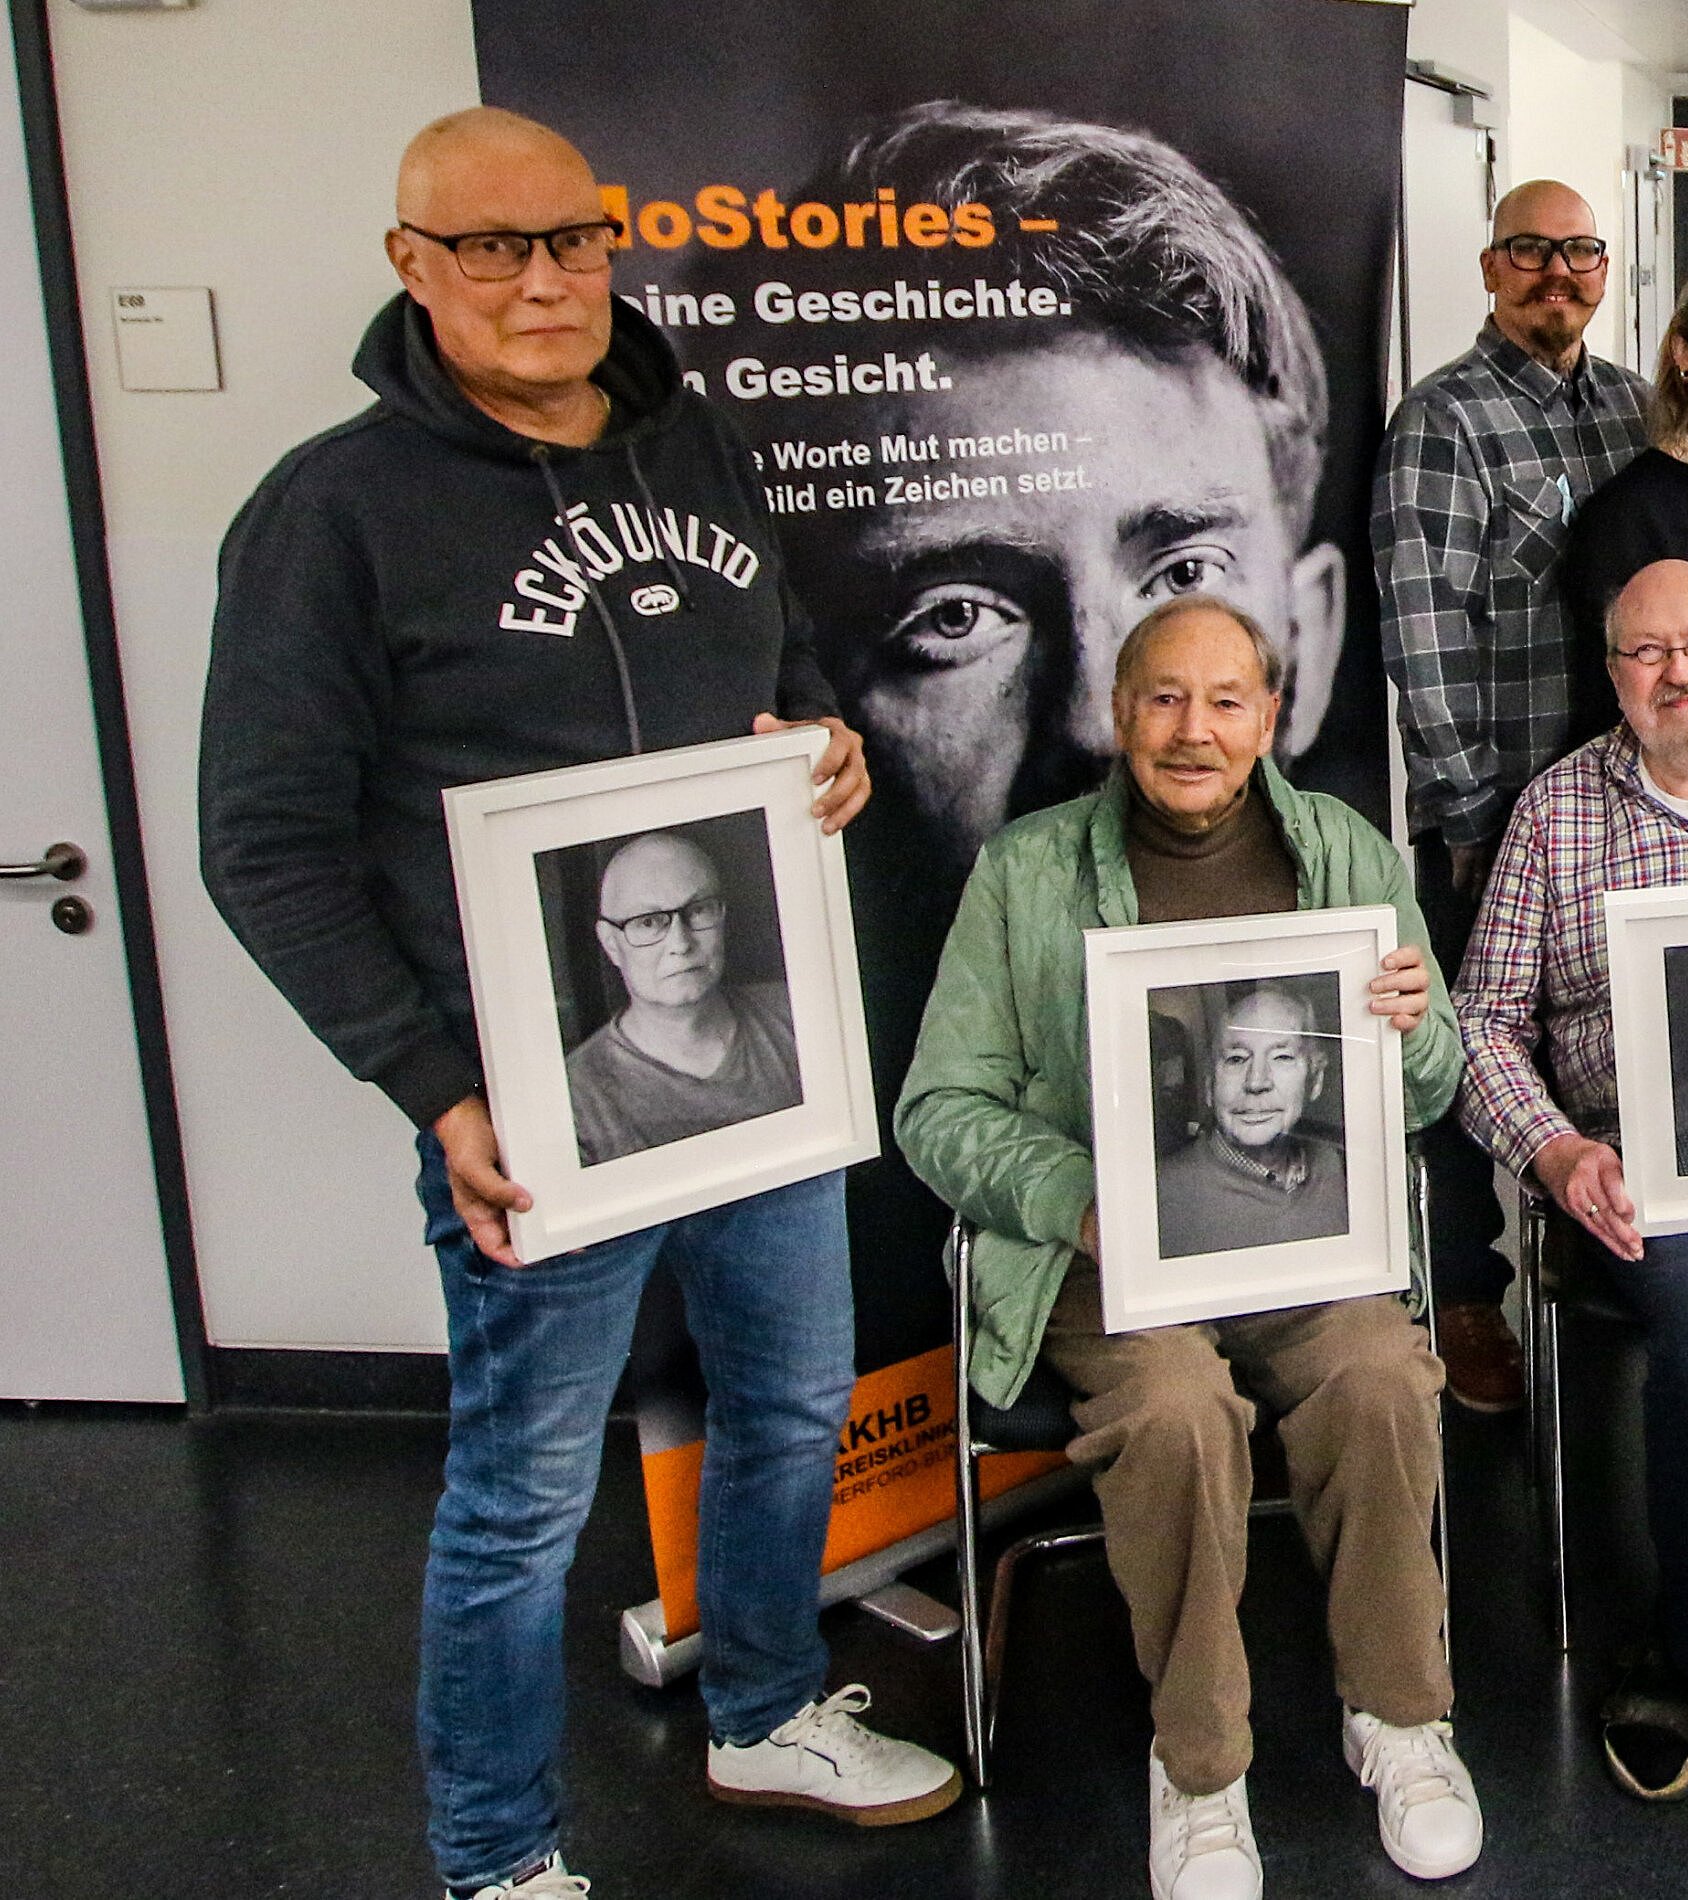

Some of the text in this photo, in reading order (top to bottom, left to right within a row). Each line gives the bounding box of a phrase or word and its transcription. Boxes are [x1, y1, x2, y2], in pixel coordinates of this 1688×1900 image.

[619, 278, 1072, 327] ine Geschichte.
[725, 352, 953, 400] Gesicht.
[771, 440, 872, 472] Worte
[880, 434, 941, 464] Mut
[949, 428, 1068, 459] machen
[826, 480, 876, 510] ein
[884, 472, 1008, 506] Zeichen
[1017, 465, 1092, 494] setzt.
[610, 502, 760, 589] UNLTD
[840, 1393, 931, 1454] KHB
[835, 1420, 957, 1484] REISKLINIK
